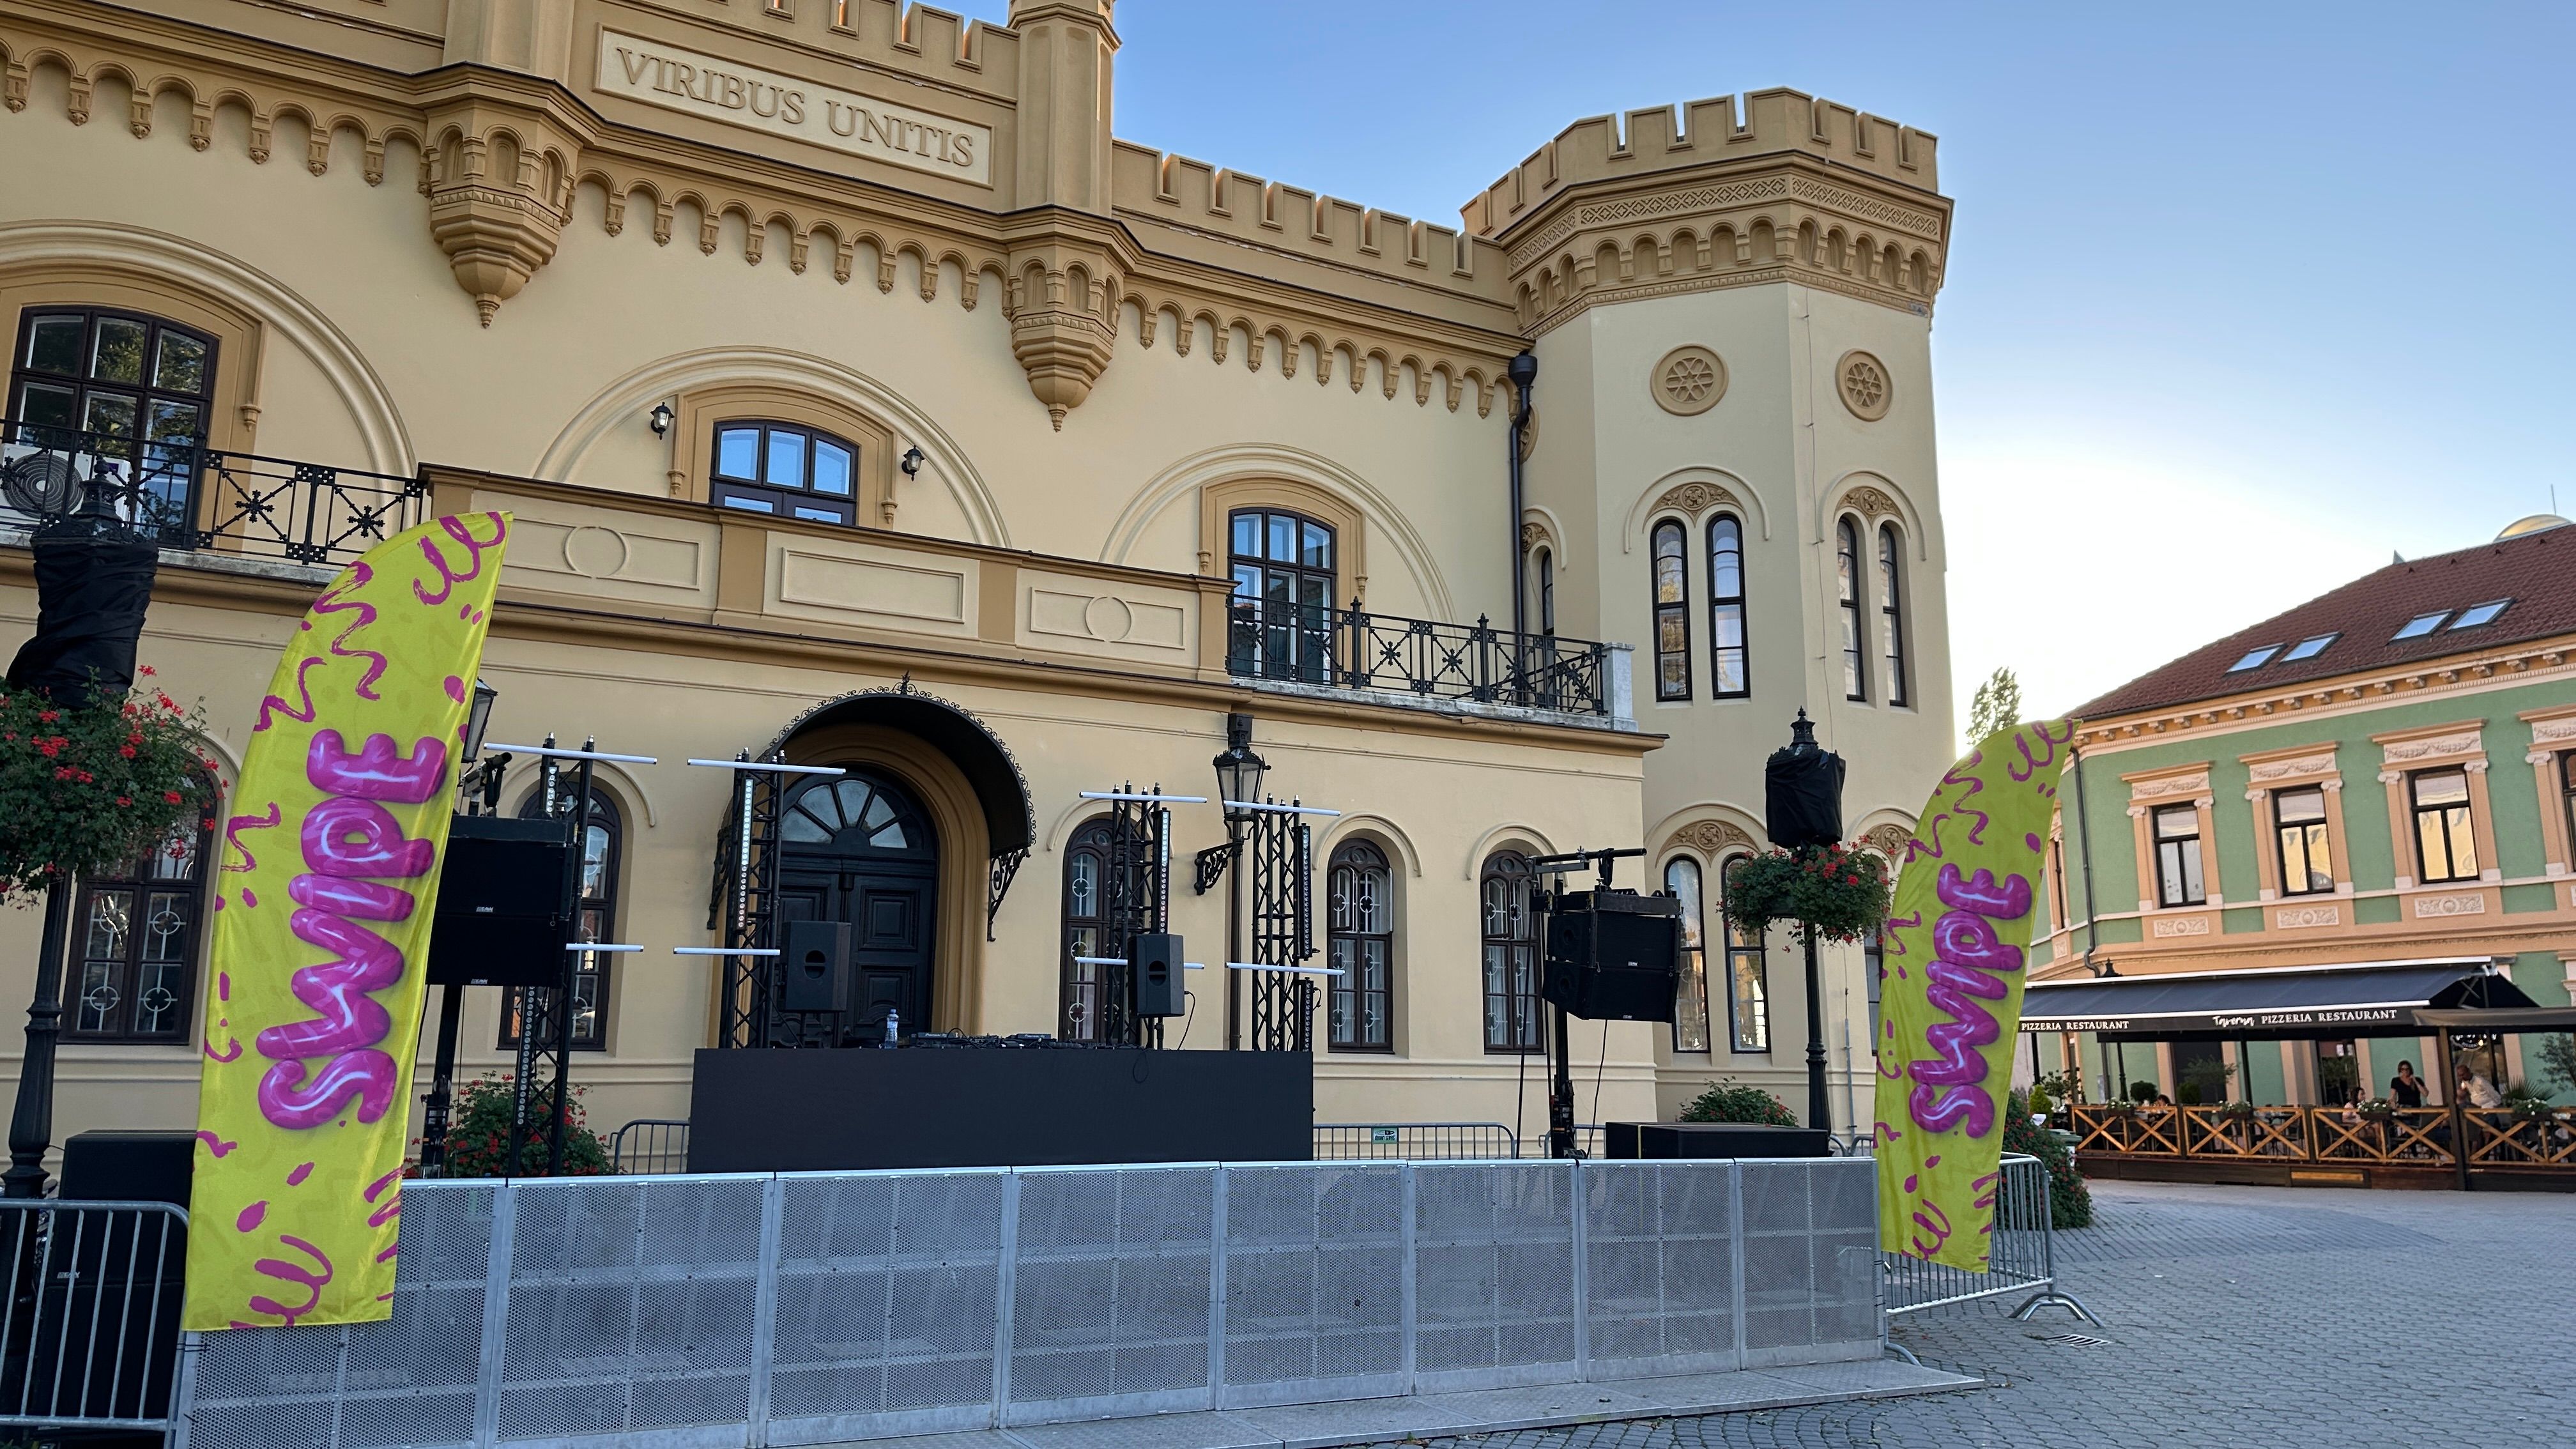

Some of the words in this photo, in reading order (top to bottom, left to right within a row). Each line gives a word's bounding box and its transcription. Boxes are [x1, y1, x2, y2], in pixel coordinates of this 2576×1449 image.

[617, 46, 806, 124] VIRIBUS
[825, 99, 974, 167] UNITIS
[255, 728, 447, 1130] SWIPE
[1907, 862, 2032, 1138] SWIPE
[2021, 1022, 2062, 1031] PIZZERIA
[2066, 1021, 2129, 1029] RESTAURANT
[2212, 1015, 2255, 1028] Taverna
[2261, 1013, 2312, 1025] PIZZERIA
[2318, 1009, 2397, 1022] RESTAURANT
